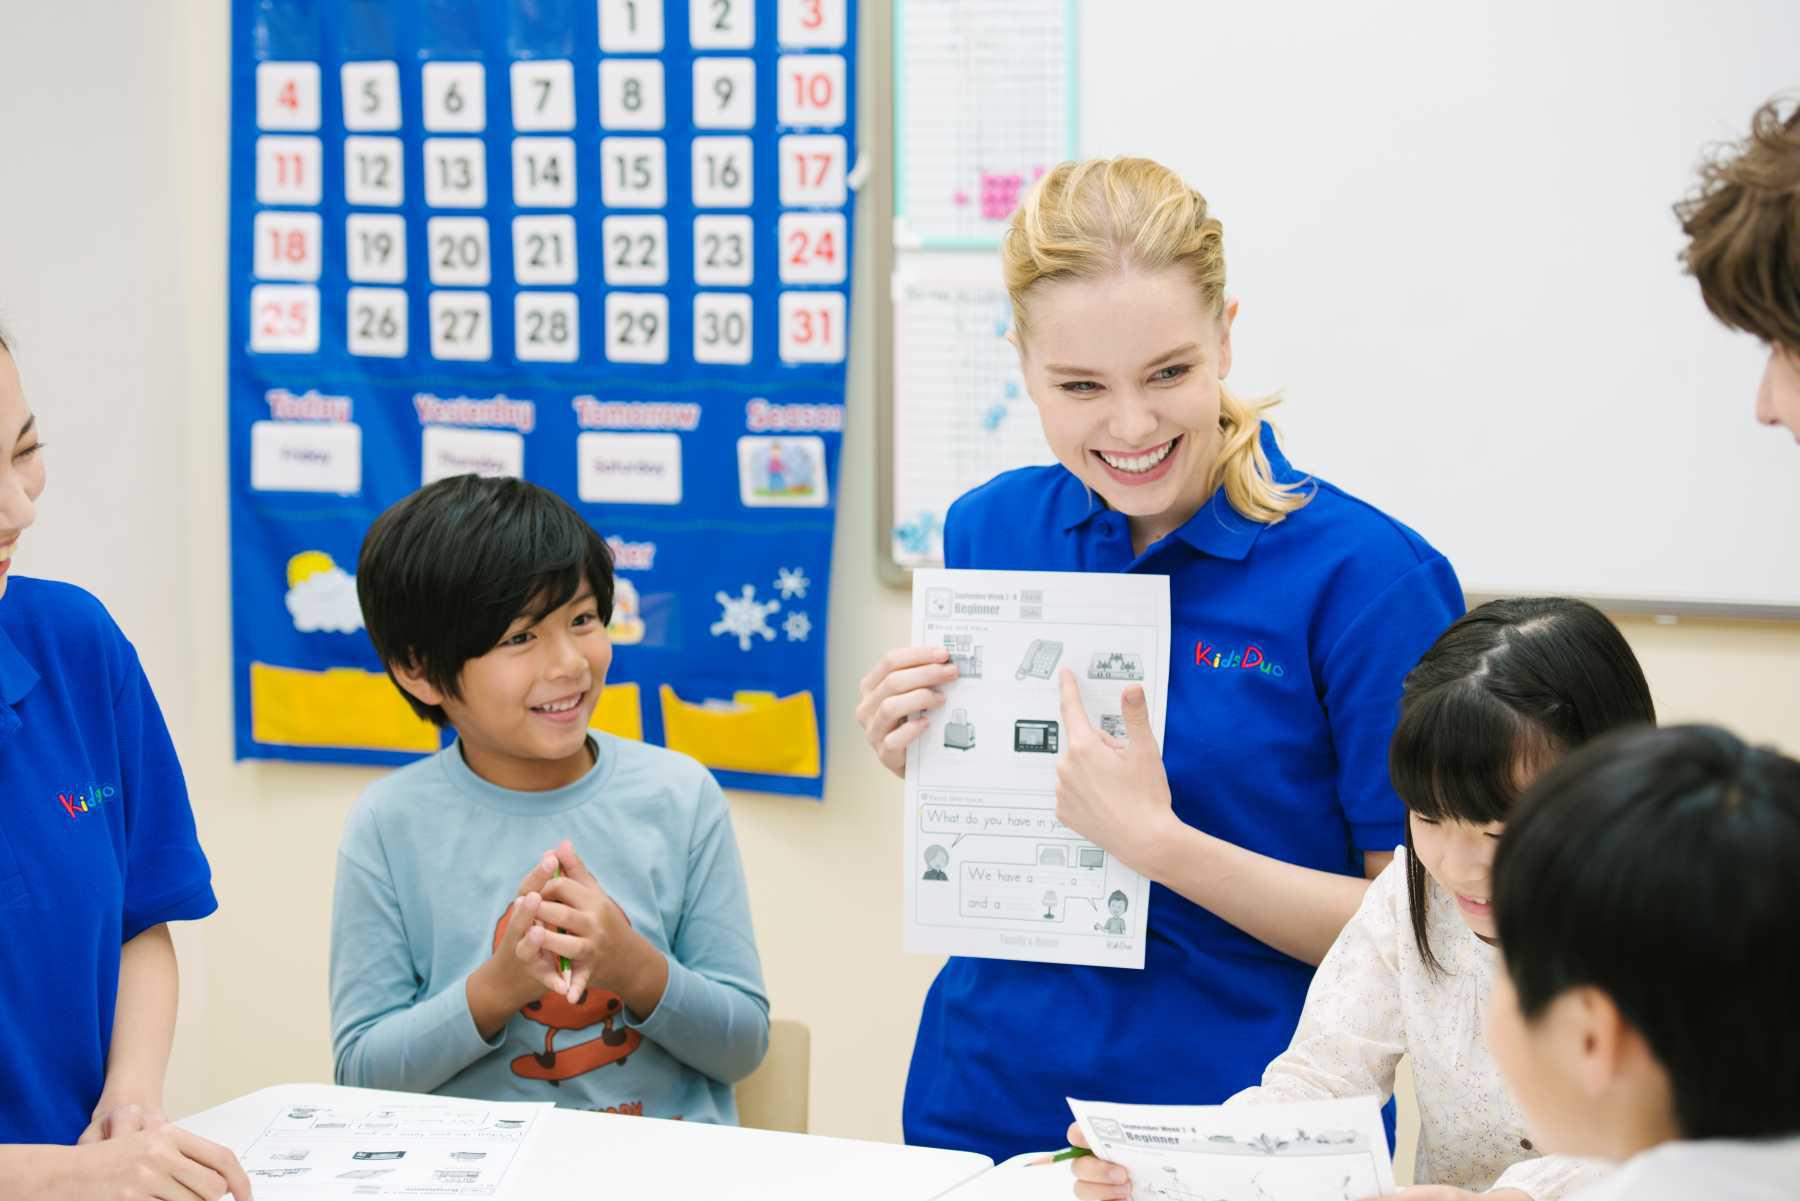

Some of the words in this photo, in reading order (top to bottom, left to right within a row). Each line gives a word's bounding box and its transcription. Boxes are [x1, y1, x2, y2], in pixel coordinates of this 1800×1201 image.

[625, 0, 637, 33] 1
[712, 0, 731, 31] 2
[802, 0, 824, 30] 3
[278, 80, 299, 110] 4
[362, 80, 380, 114] 5
[445, 81, 464, 114] 6
[533, 80, 553, 113] 7
[622, 78, 643, 112] 8
[714, 76, 736, 109] 9
[793, 73, 833, 109] 10
[275, 153, 304, 186] 11
[358, 155, 390, 189] 12
[439, 156, 473, 191] 13
[527, 156, 561, 186] 14
[616, 155, 652, 190] 15
[707, 155, 740, 189] 16
[795, 153, 833, 187] 17
[271, 229, 307, 264] 18
[361, 232, 391, 265] 19
[438, 234, 481, 269] 20
[527, 233, 563, 267] 21
[614, 234, 656, 268] 22
[704, 234, 744, 268] 23
[791, 231, 835, 264] 24
[260, 304, 307, 336] 25
[358, 306, 398, 339] 26
[441, 309, 481, 343] 27
[526, 310, 569, 344] 28
[617, 312, 659, 344] 29
[702, 312, 745, 346] 30
[793, 309, 830, 344] 31
[265, 389, 351, 421] Today
[413, 393, 535, 433] Yesterday
[572, 395, 700, 430] Tomorrow
[1195, 640, 1284, 677] KidsDuo
[927, 809, 960, 824] What
[966, 813, 979, 825] do
[984, 818, 1003, 831] you
[1008, 815, 1031, 828] have
[1037, 816, 1047, 828] in
[968, 866, 992, 881] We
[998, 870, 1021, 883] have
[1026, 875, 1034, 884] a
[968, 896, 988, 909] and
[994, 902, 1001, 910] a
[1125, 1131, 1181, 1145] Beginner
